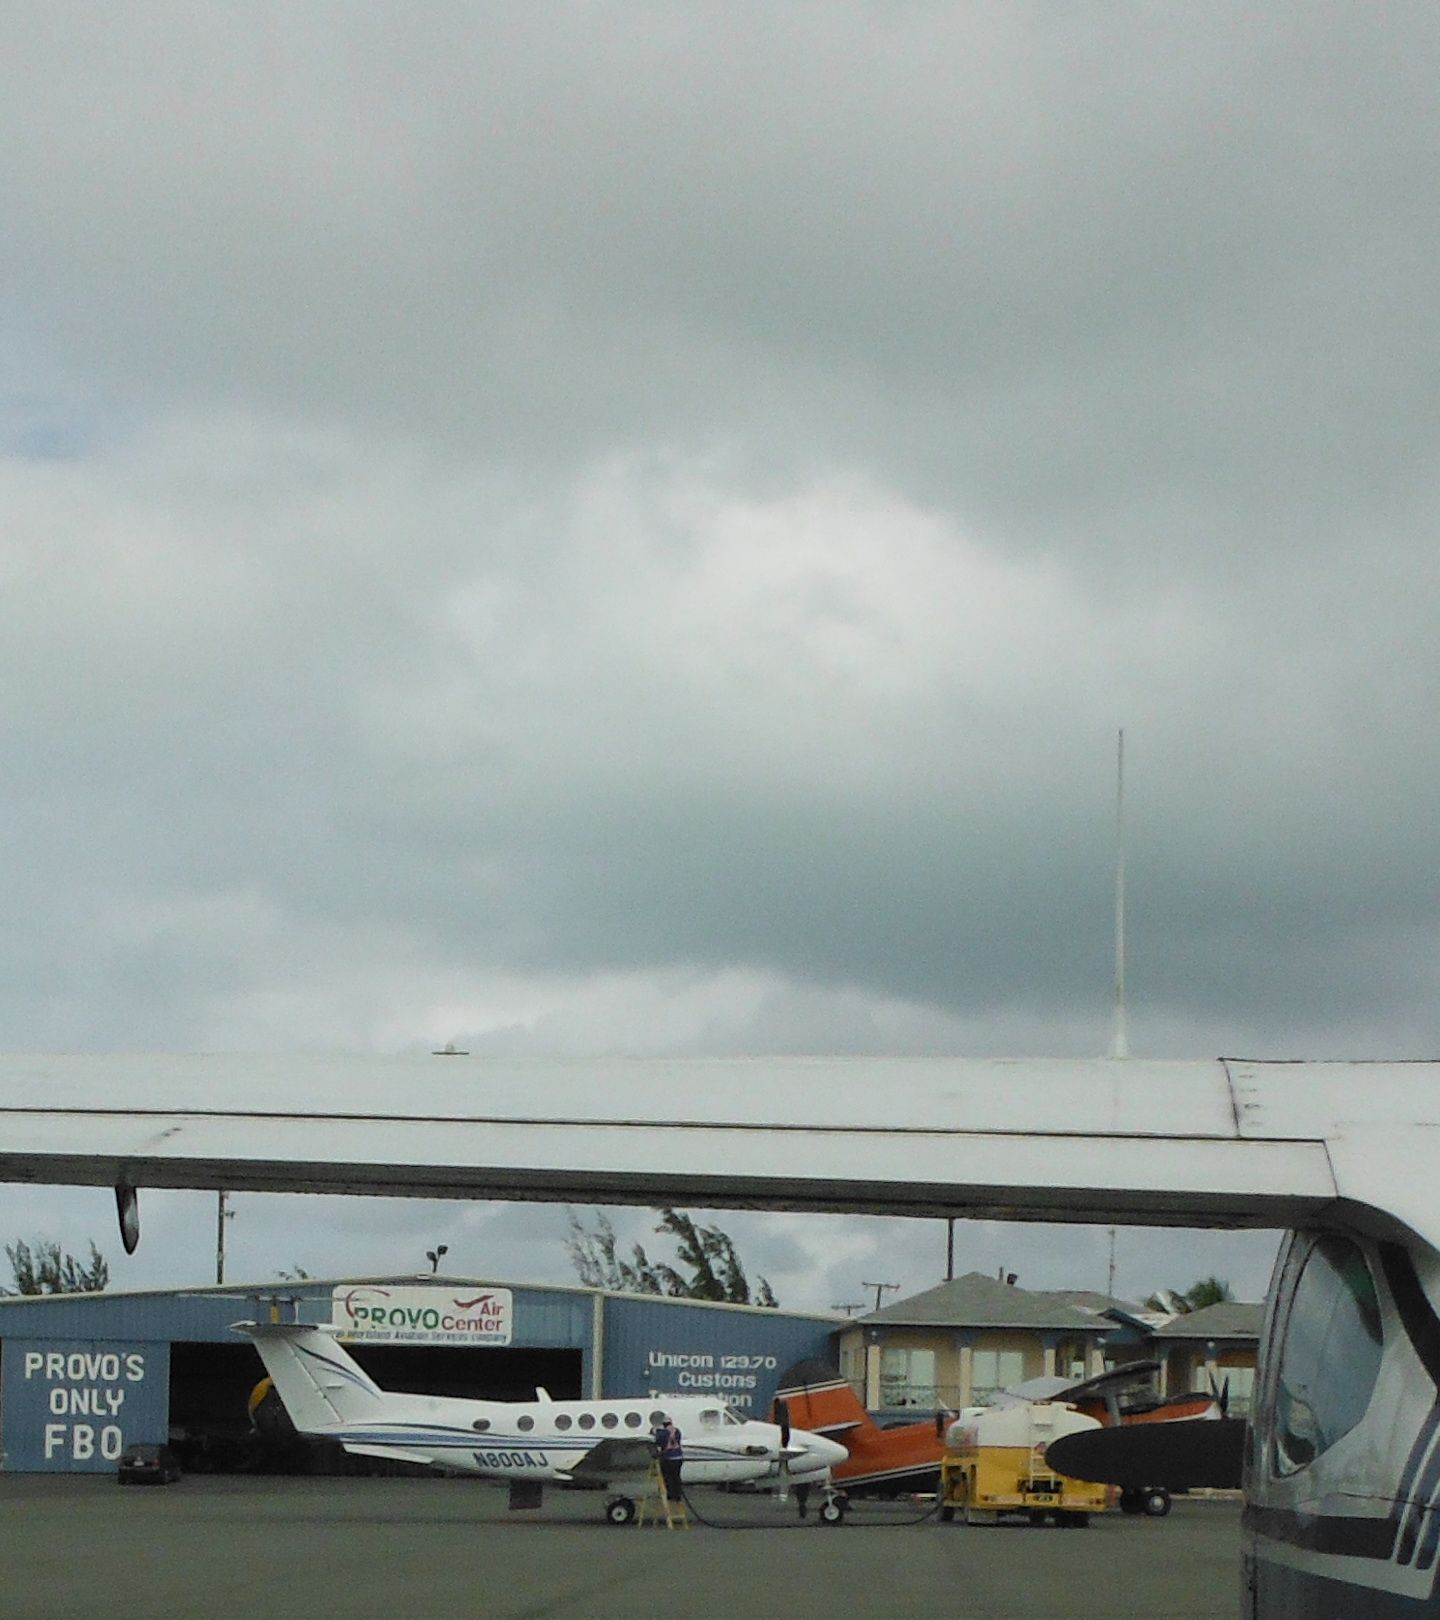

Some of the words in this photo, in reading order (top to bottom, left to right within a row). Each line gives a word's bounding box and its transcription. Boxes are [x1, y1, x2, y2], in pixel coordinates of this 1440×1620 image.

[353, 1307, 440, 1330] PROVO
[480, 1302, 504, 1316] Air
[441, 1316, 503, 1332] Center
[25, 1352, 144, 1381] PROVO'S
[49, 1388, 125, 1416] ONLY
[45, 1424, 122, 1460] FBO
[473, 1452, 549, 1468] N800AJ
